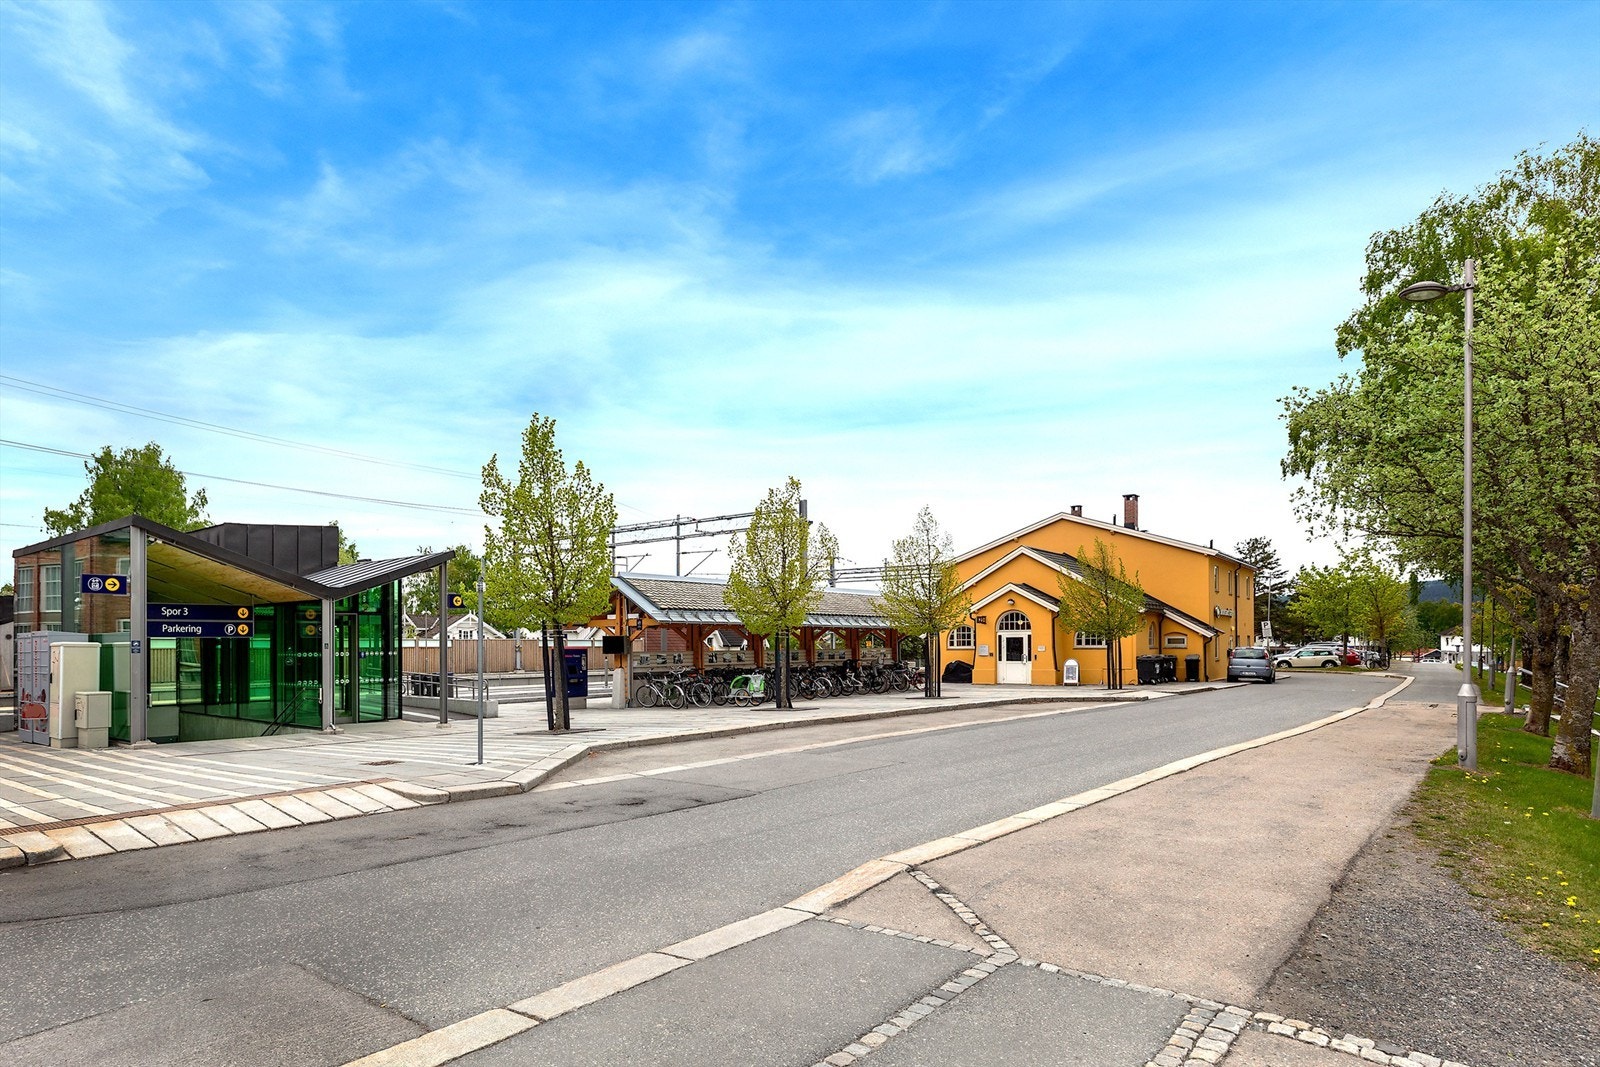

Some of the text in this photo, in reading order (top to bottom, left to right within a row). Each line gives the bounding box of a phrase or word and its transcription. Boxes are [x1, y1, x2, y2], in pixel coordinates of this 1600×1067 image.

[161, 606, 188, 617] Spor 3
[162, 624, 202, 634] Parkering
